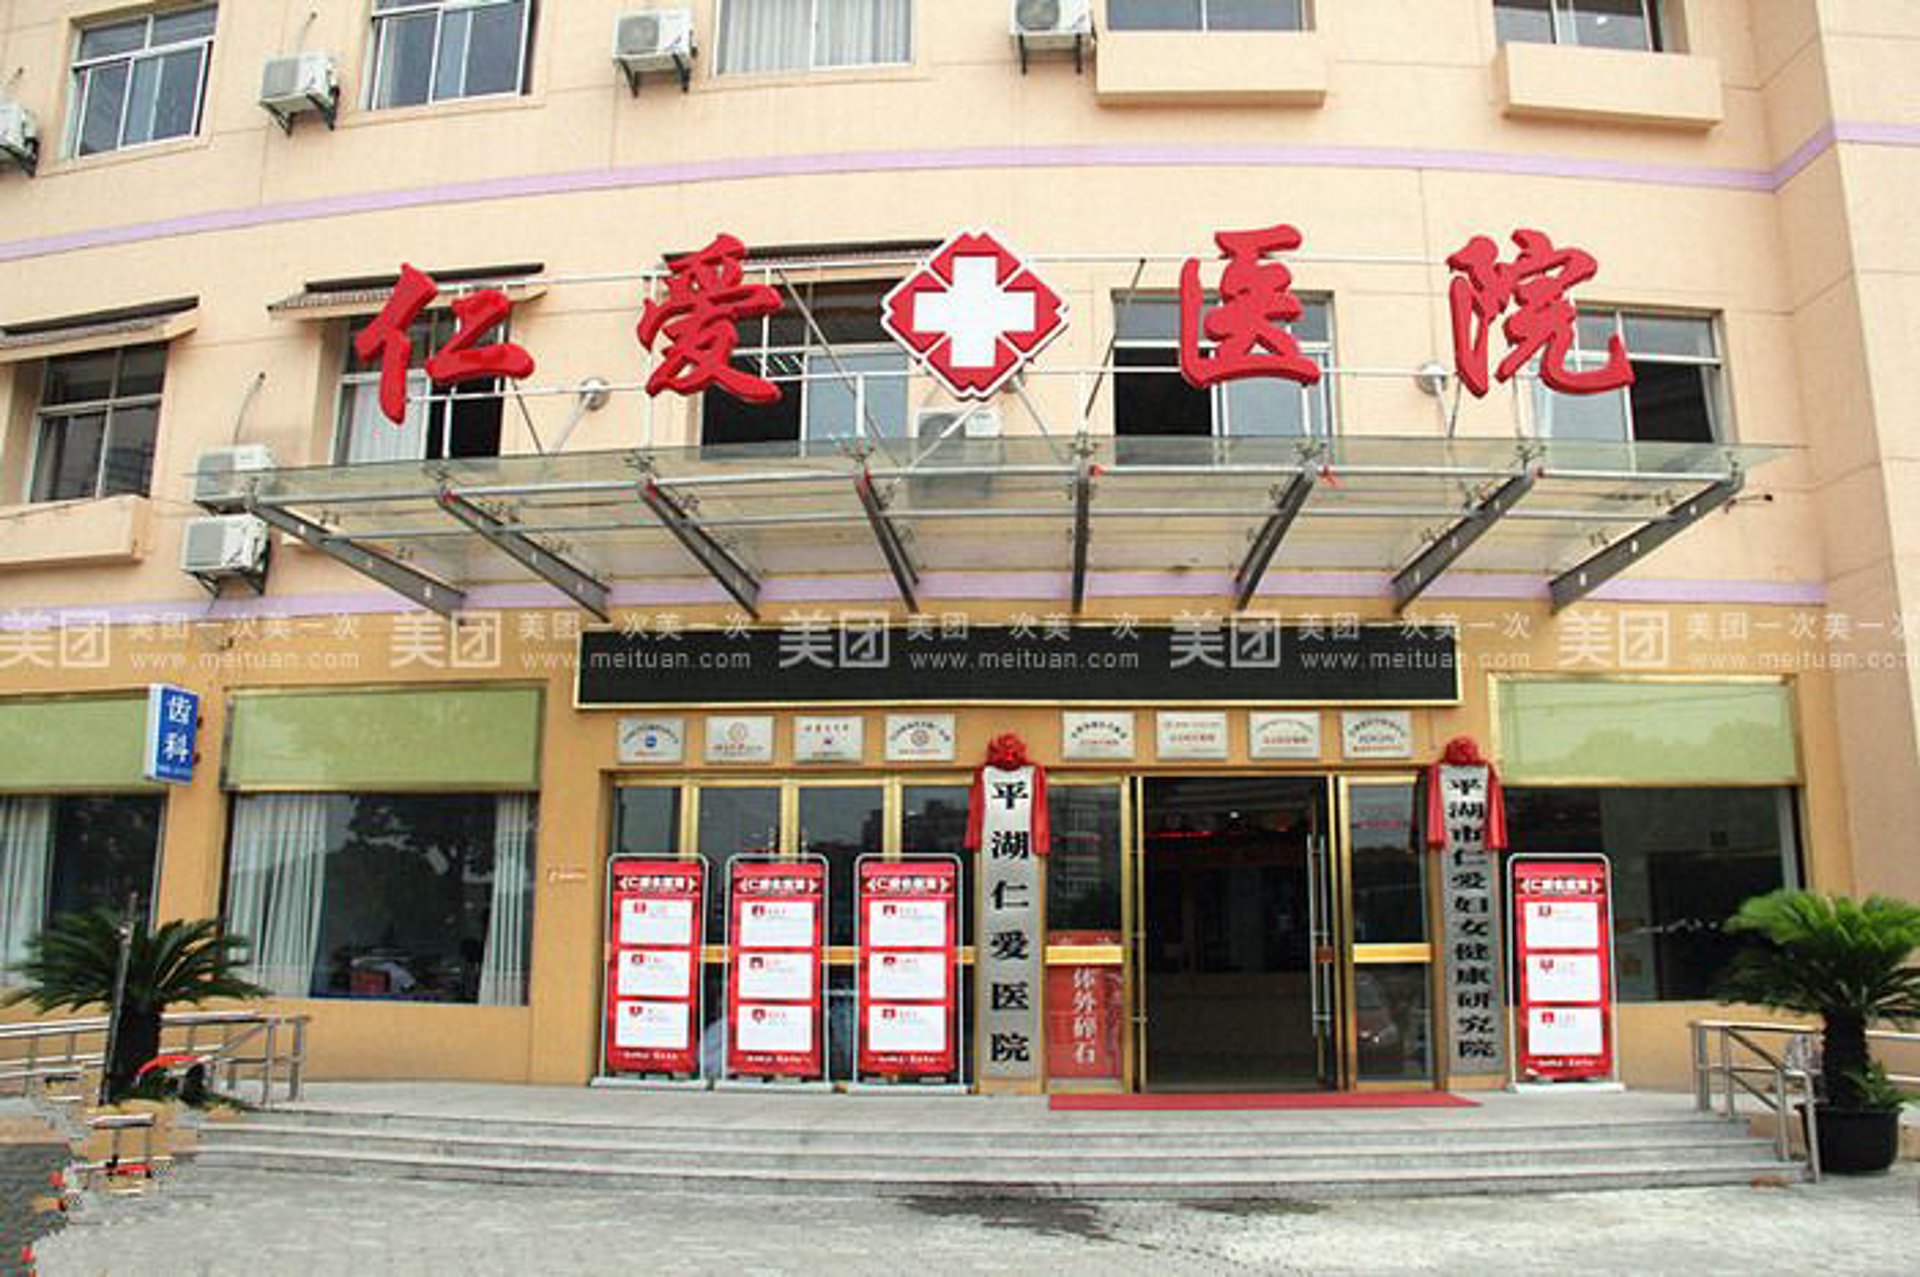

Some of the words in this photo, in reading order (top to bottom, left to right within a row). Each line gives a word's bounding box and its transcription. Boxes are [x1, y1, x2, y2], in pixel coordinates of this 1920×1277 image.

[162, 695, 193, 763] 齿科
[989, 780, 1031, 1064] 平湖仁爱医院
[1448, 777, 1495, 1059] 平湖市仁爱妇女健康研究院
